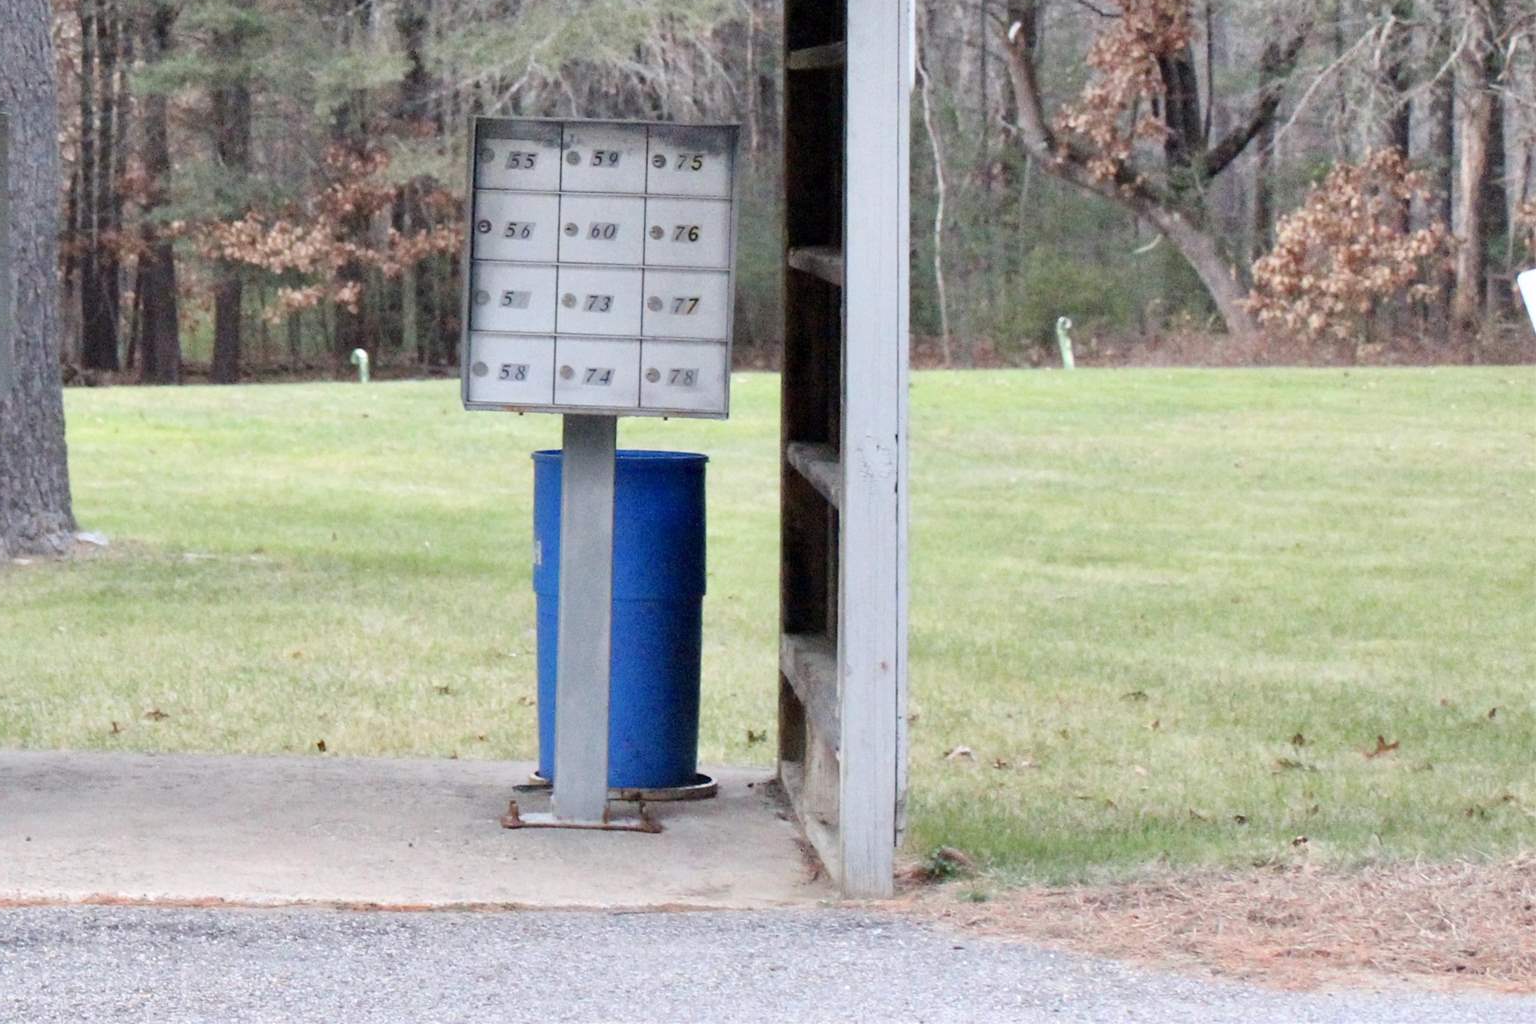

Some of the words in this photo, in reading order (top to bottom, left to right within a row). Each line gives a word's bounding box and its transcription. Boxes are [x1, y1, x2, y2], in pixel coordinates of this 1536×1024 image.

[510, 153, 536, 169] 55
[593, 152, 619, 166] 59
[677, 153, 703, 170] 75
[505, 223, 531, 238] 56
[591, 223, 616, 238] 60
[675, 226, 699, 242] 76
[588, 296, 612, 311] 73
[675, 298, 700, 314] 77
[500, 365, 526, 379] 58
[586, 370, 612, 384] 74
[670, 370, 694, 385] 78
